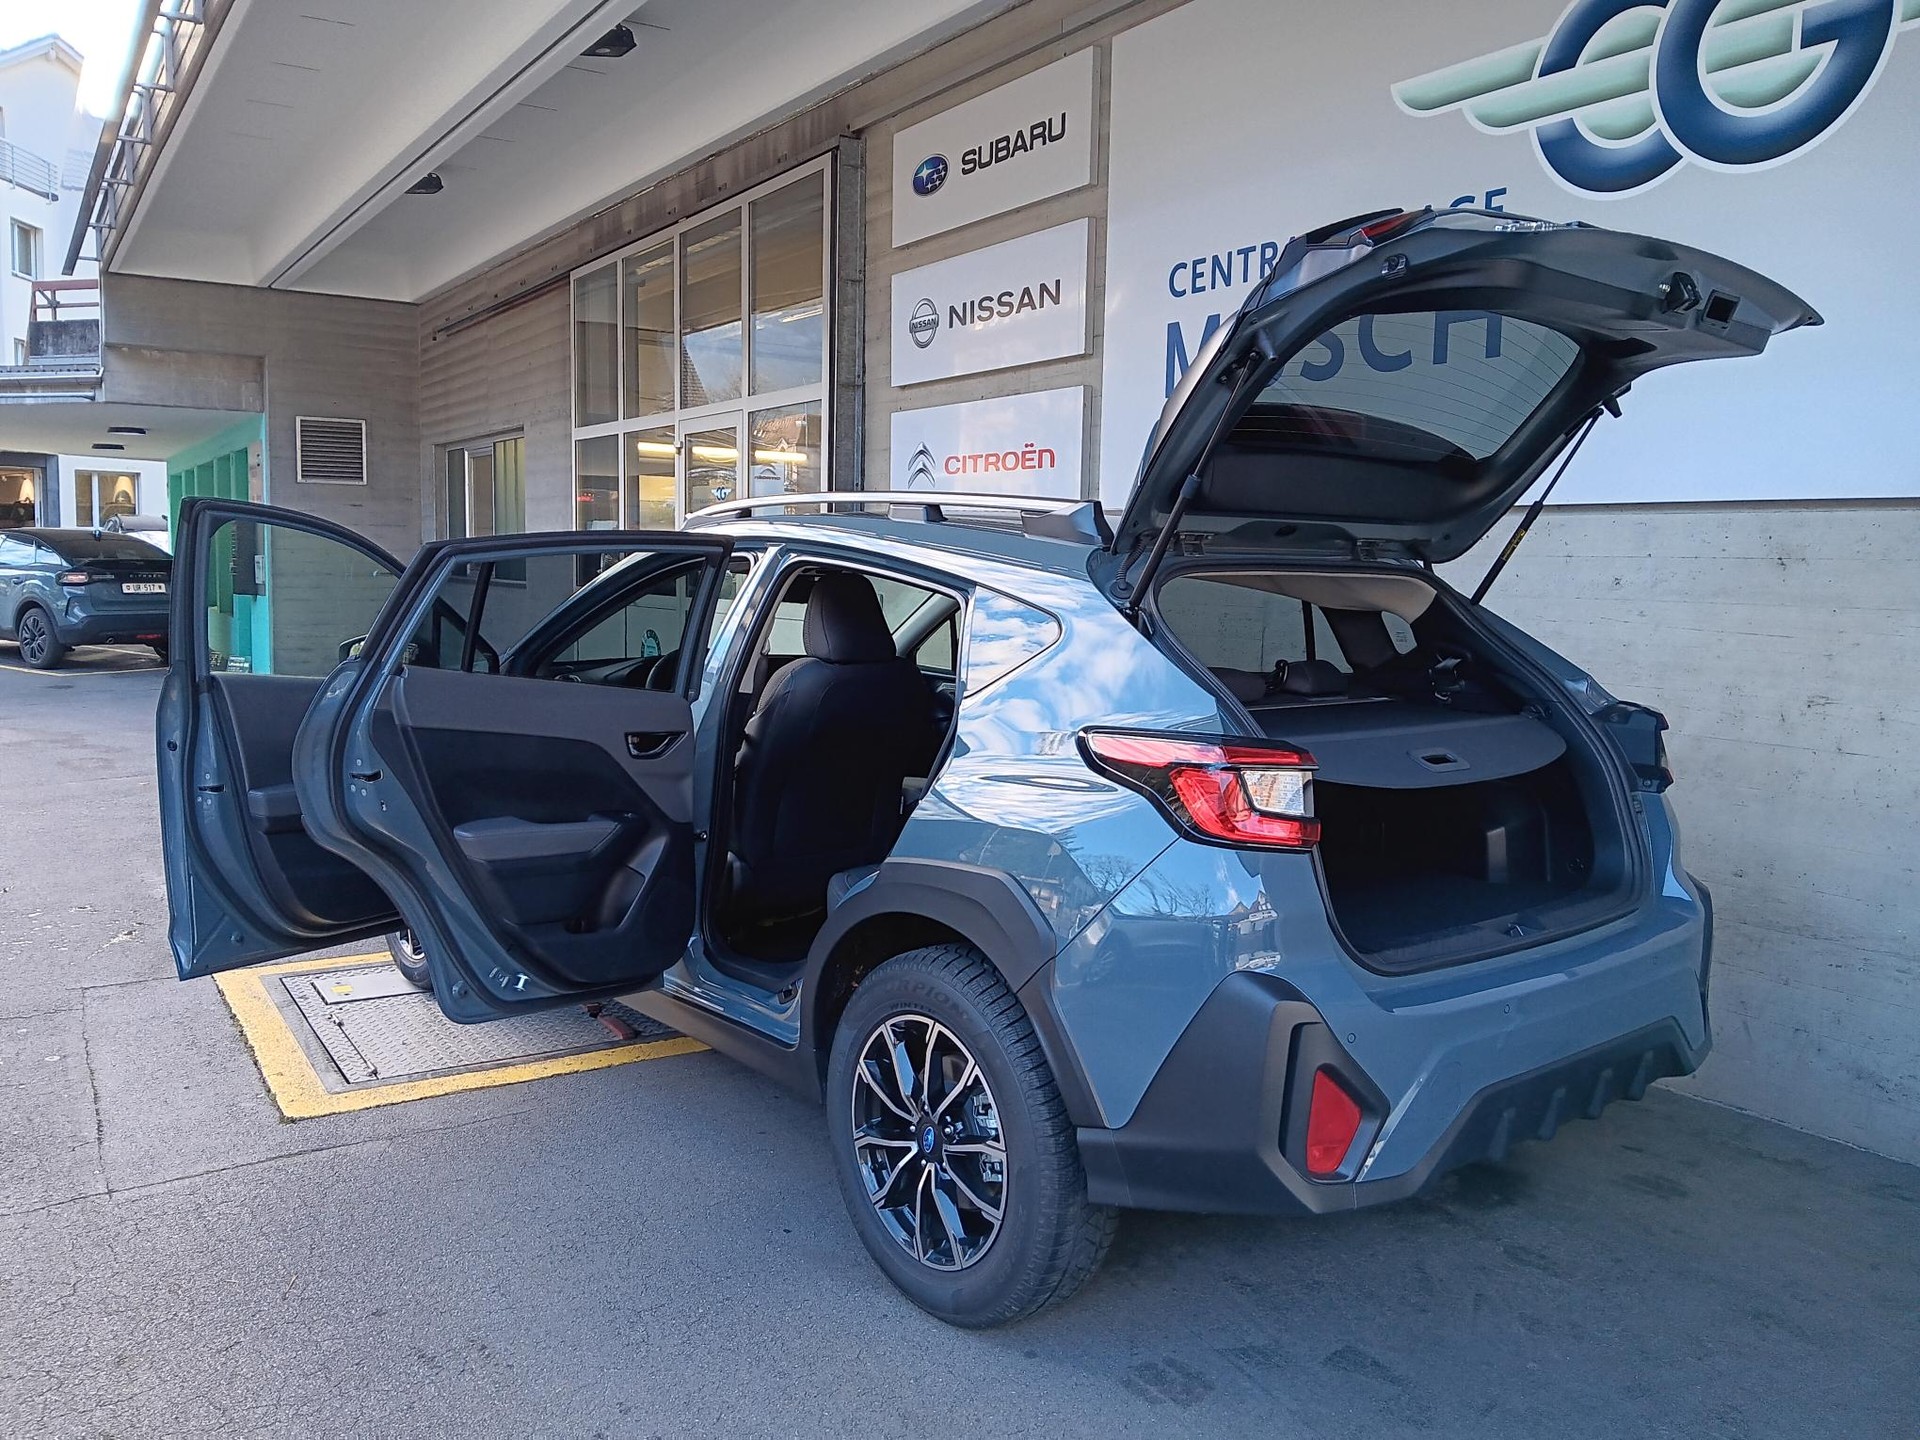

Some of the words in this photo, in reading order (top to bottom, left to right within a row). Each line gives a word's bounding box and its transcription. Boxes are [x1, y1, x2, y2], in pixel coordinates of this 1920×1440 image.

[961, 112, 1066, 175] SUBARU
[1168, 236, 1295, 298] CENTR
[911, 317, 937, 329] NISSAN
[949, 279, 1060, 328] NISSAN
[1164, 309, 1503, 399] MSCH
